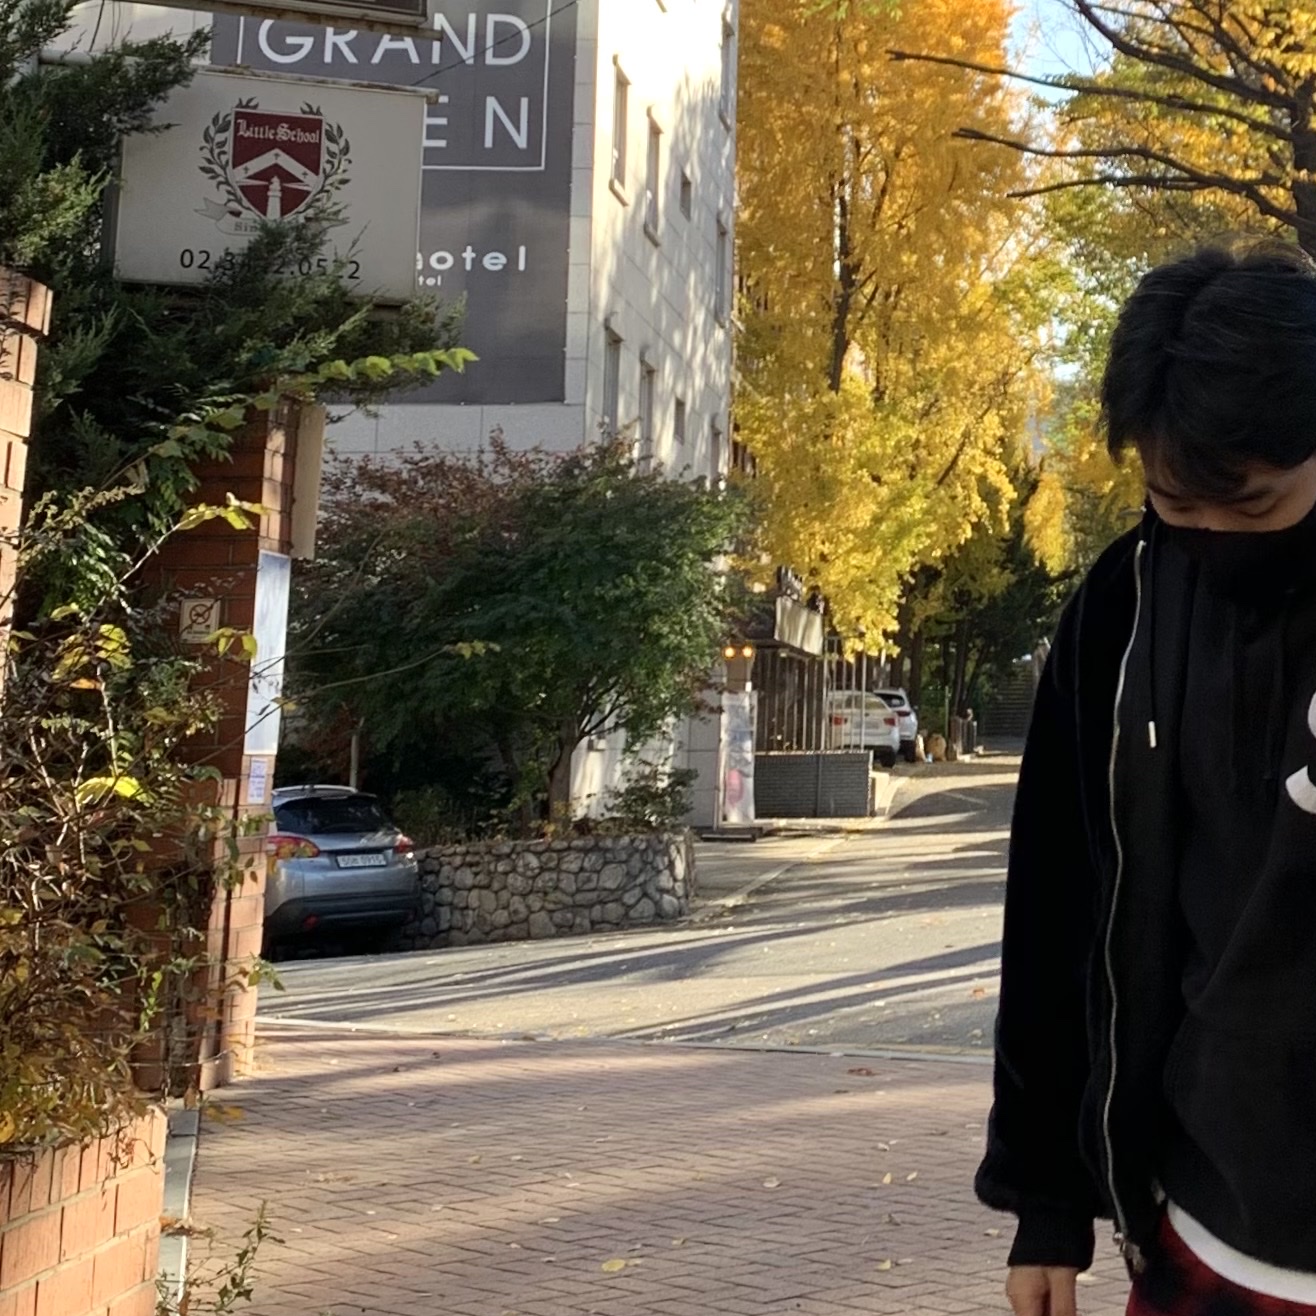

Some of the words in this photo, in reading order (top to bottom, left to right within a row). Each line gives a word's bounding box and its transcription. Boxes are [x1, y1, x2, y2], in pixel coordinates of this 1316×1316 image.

[258, 13, 531, 64] GRAND
[237, 119, 276, 140] Little
[276, 123, 320, 144] School
